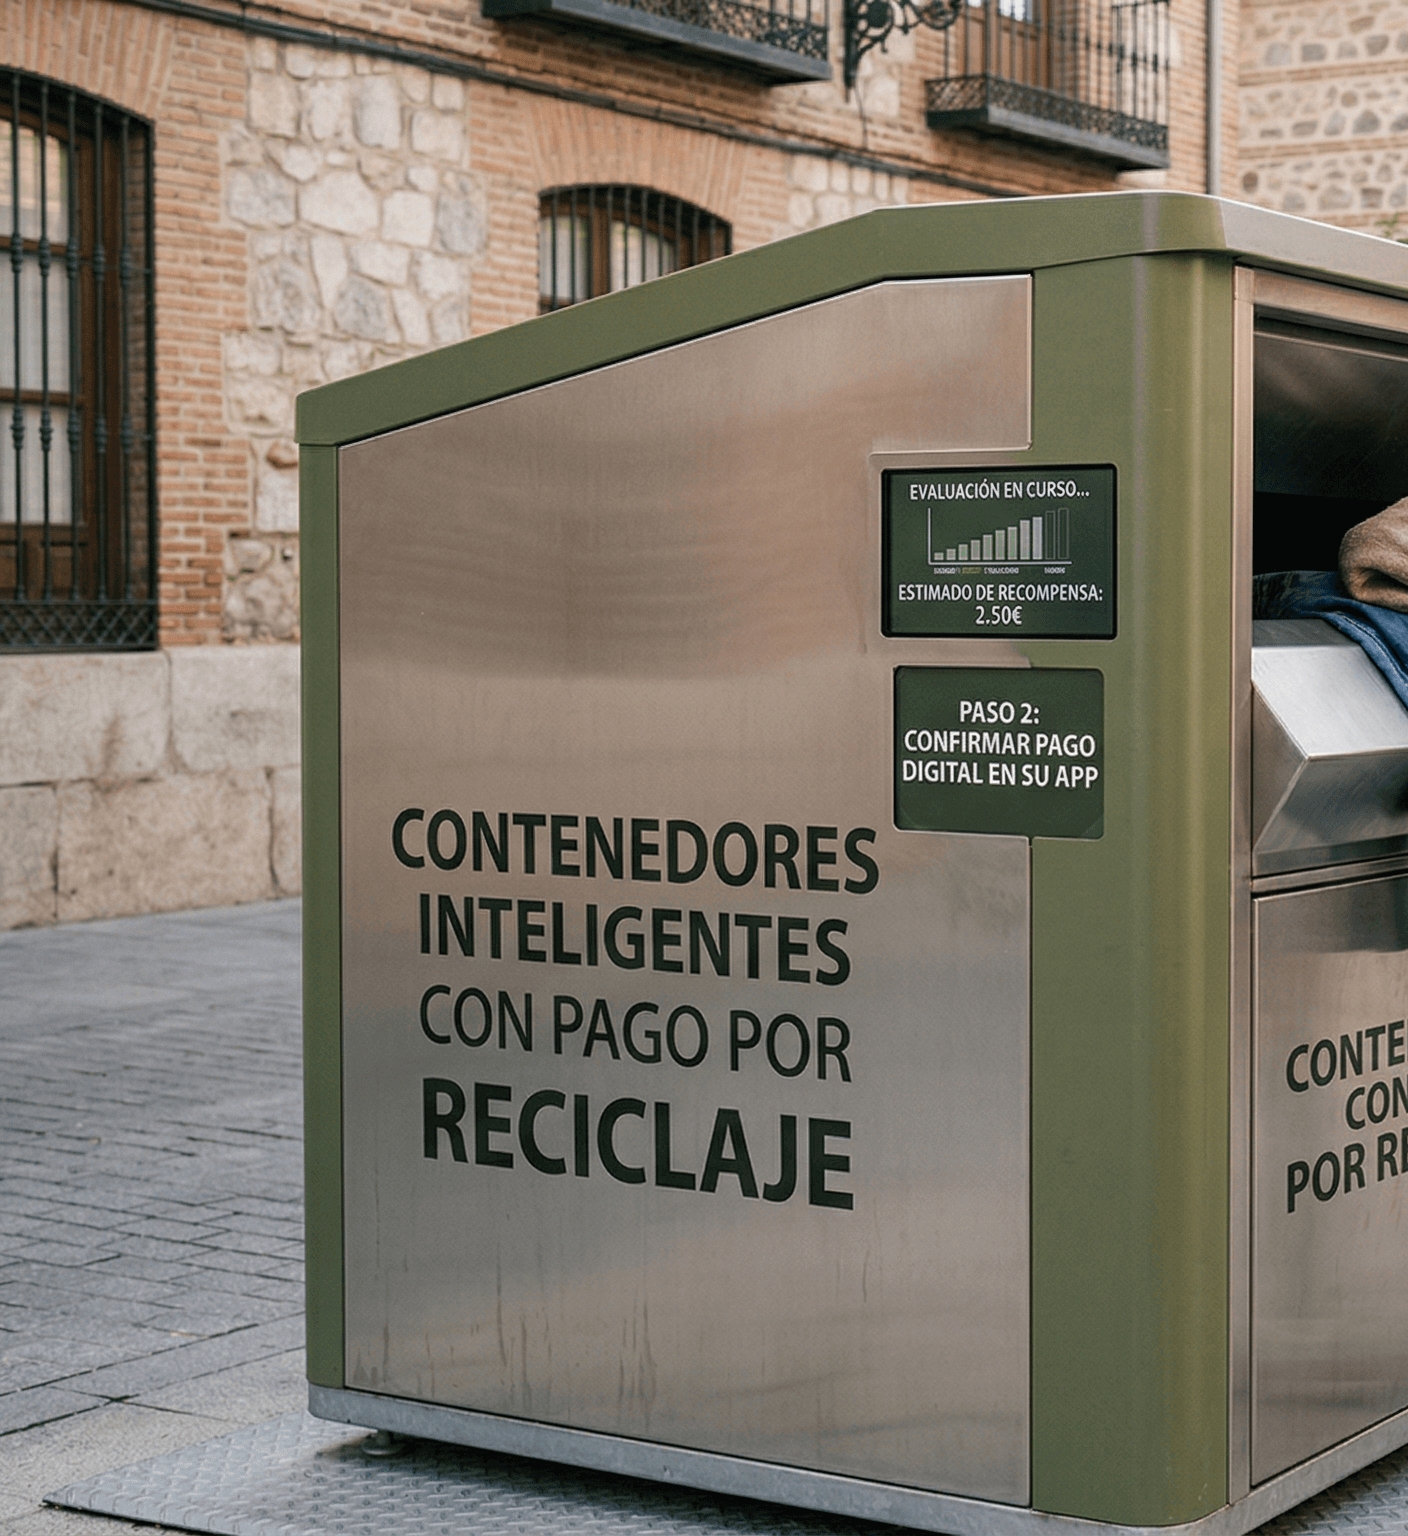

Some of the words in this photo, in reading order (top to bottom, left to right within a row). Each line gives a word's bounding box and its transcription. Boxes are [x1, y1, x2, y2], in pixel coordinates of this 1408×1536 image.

[910, 478, 1000, 500] EVALUACIÓN
[1004, 481, 1023, 499] EN
[1026, 480, 1090, 498] CURSO...
[898, 583, 972, 601] ESTIMADO
[975, 583, 994, 601] DE
[998, 583, 1103, 602] RECOMPENSA:
[975, 605, 1023, 625] 2.50€
[959, 700, 1015, 724] PASO
[1020, 702, 1040, 725] 2:
[904, 729, 1031, 756] CONFIRMAR
[1035, 733, 1096, 758] PAGO
[902, 759, 984, 784] DIGITAL
[988, 762, 1016, 786] EN
[1021, 763, 1049, 787] SU
[1054, 765, 1099, 789] APP
[391, 807, 880, 895] CONTENEDORES
[419, 893, 851, 987] INTELIGENTES
[419, 984, 533, 1053] CON
[553, 994, 710, 1069] PAGO
[729, 1009, 853, 1084] POR
[421, 1076, 855, 1212] RECICLAJE
[1286, 1142, 1367, 1214] POR
